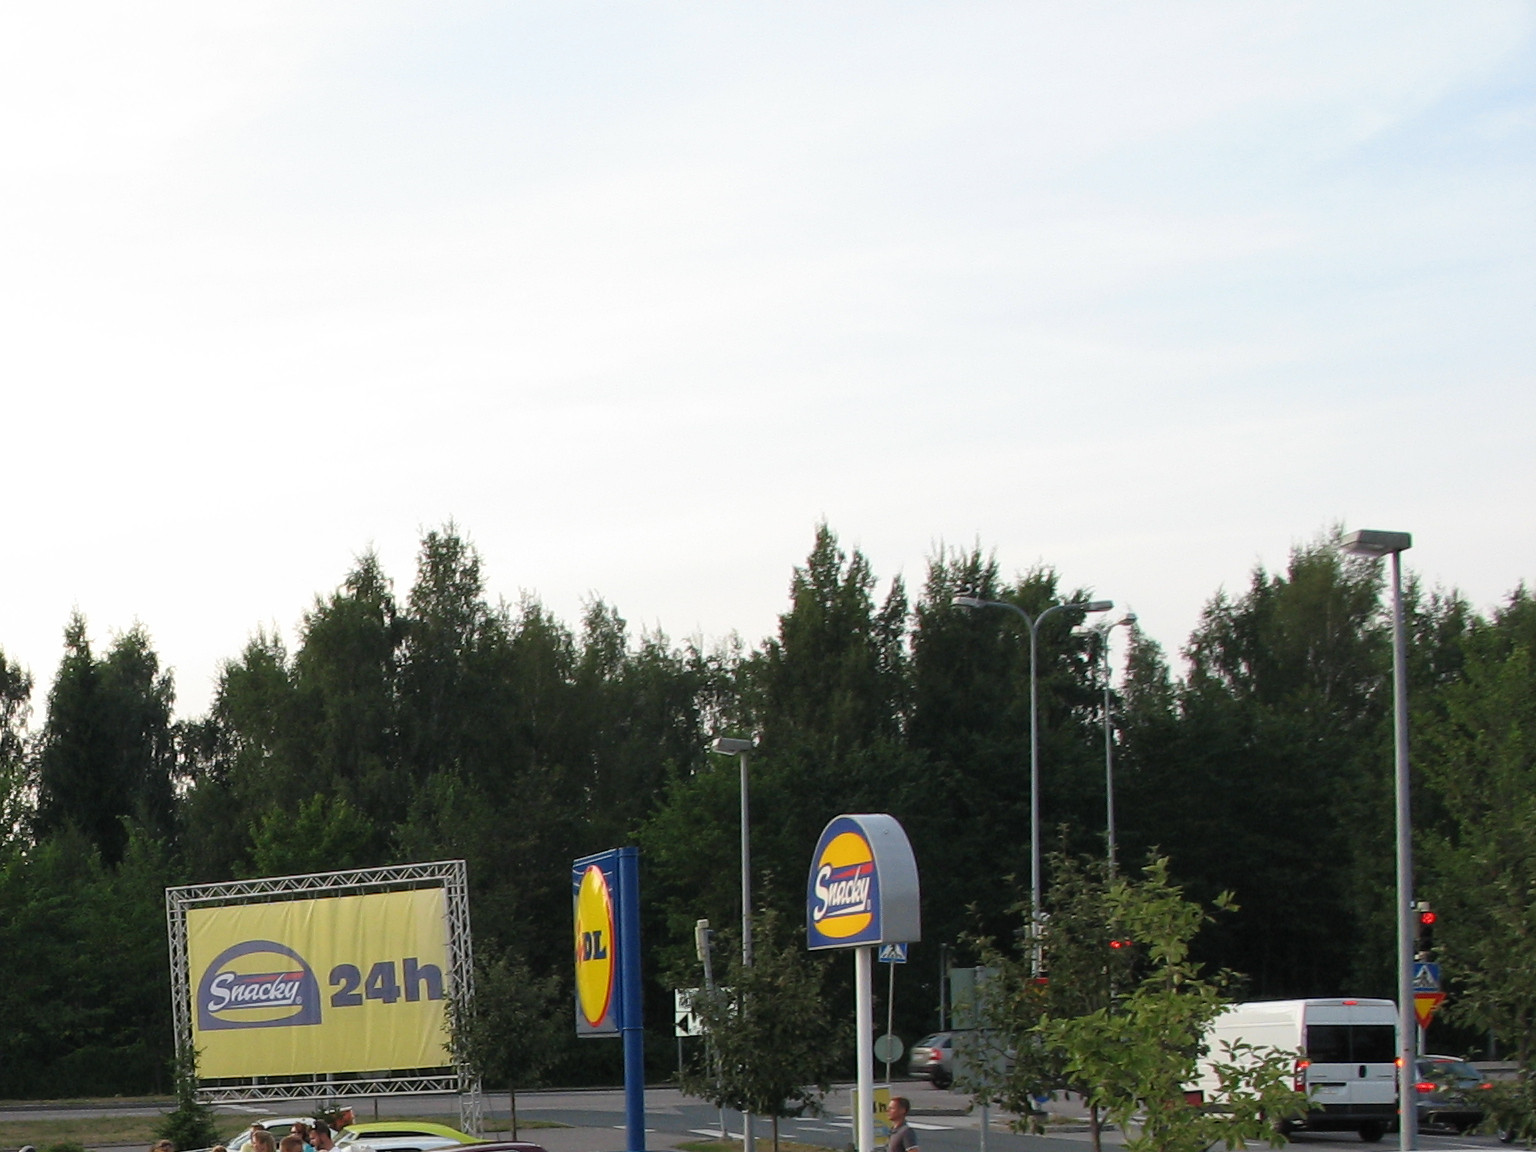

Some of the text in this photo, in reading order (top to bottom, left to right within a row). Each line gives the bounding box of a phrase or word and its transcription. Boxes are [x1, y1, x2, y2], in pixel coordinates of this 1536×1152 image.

[813, 865, 870, 920] Snacky
[208, 957, 444, 1012] Snacky 24h
